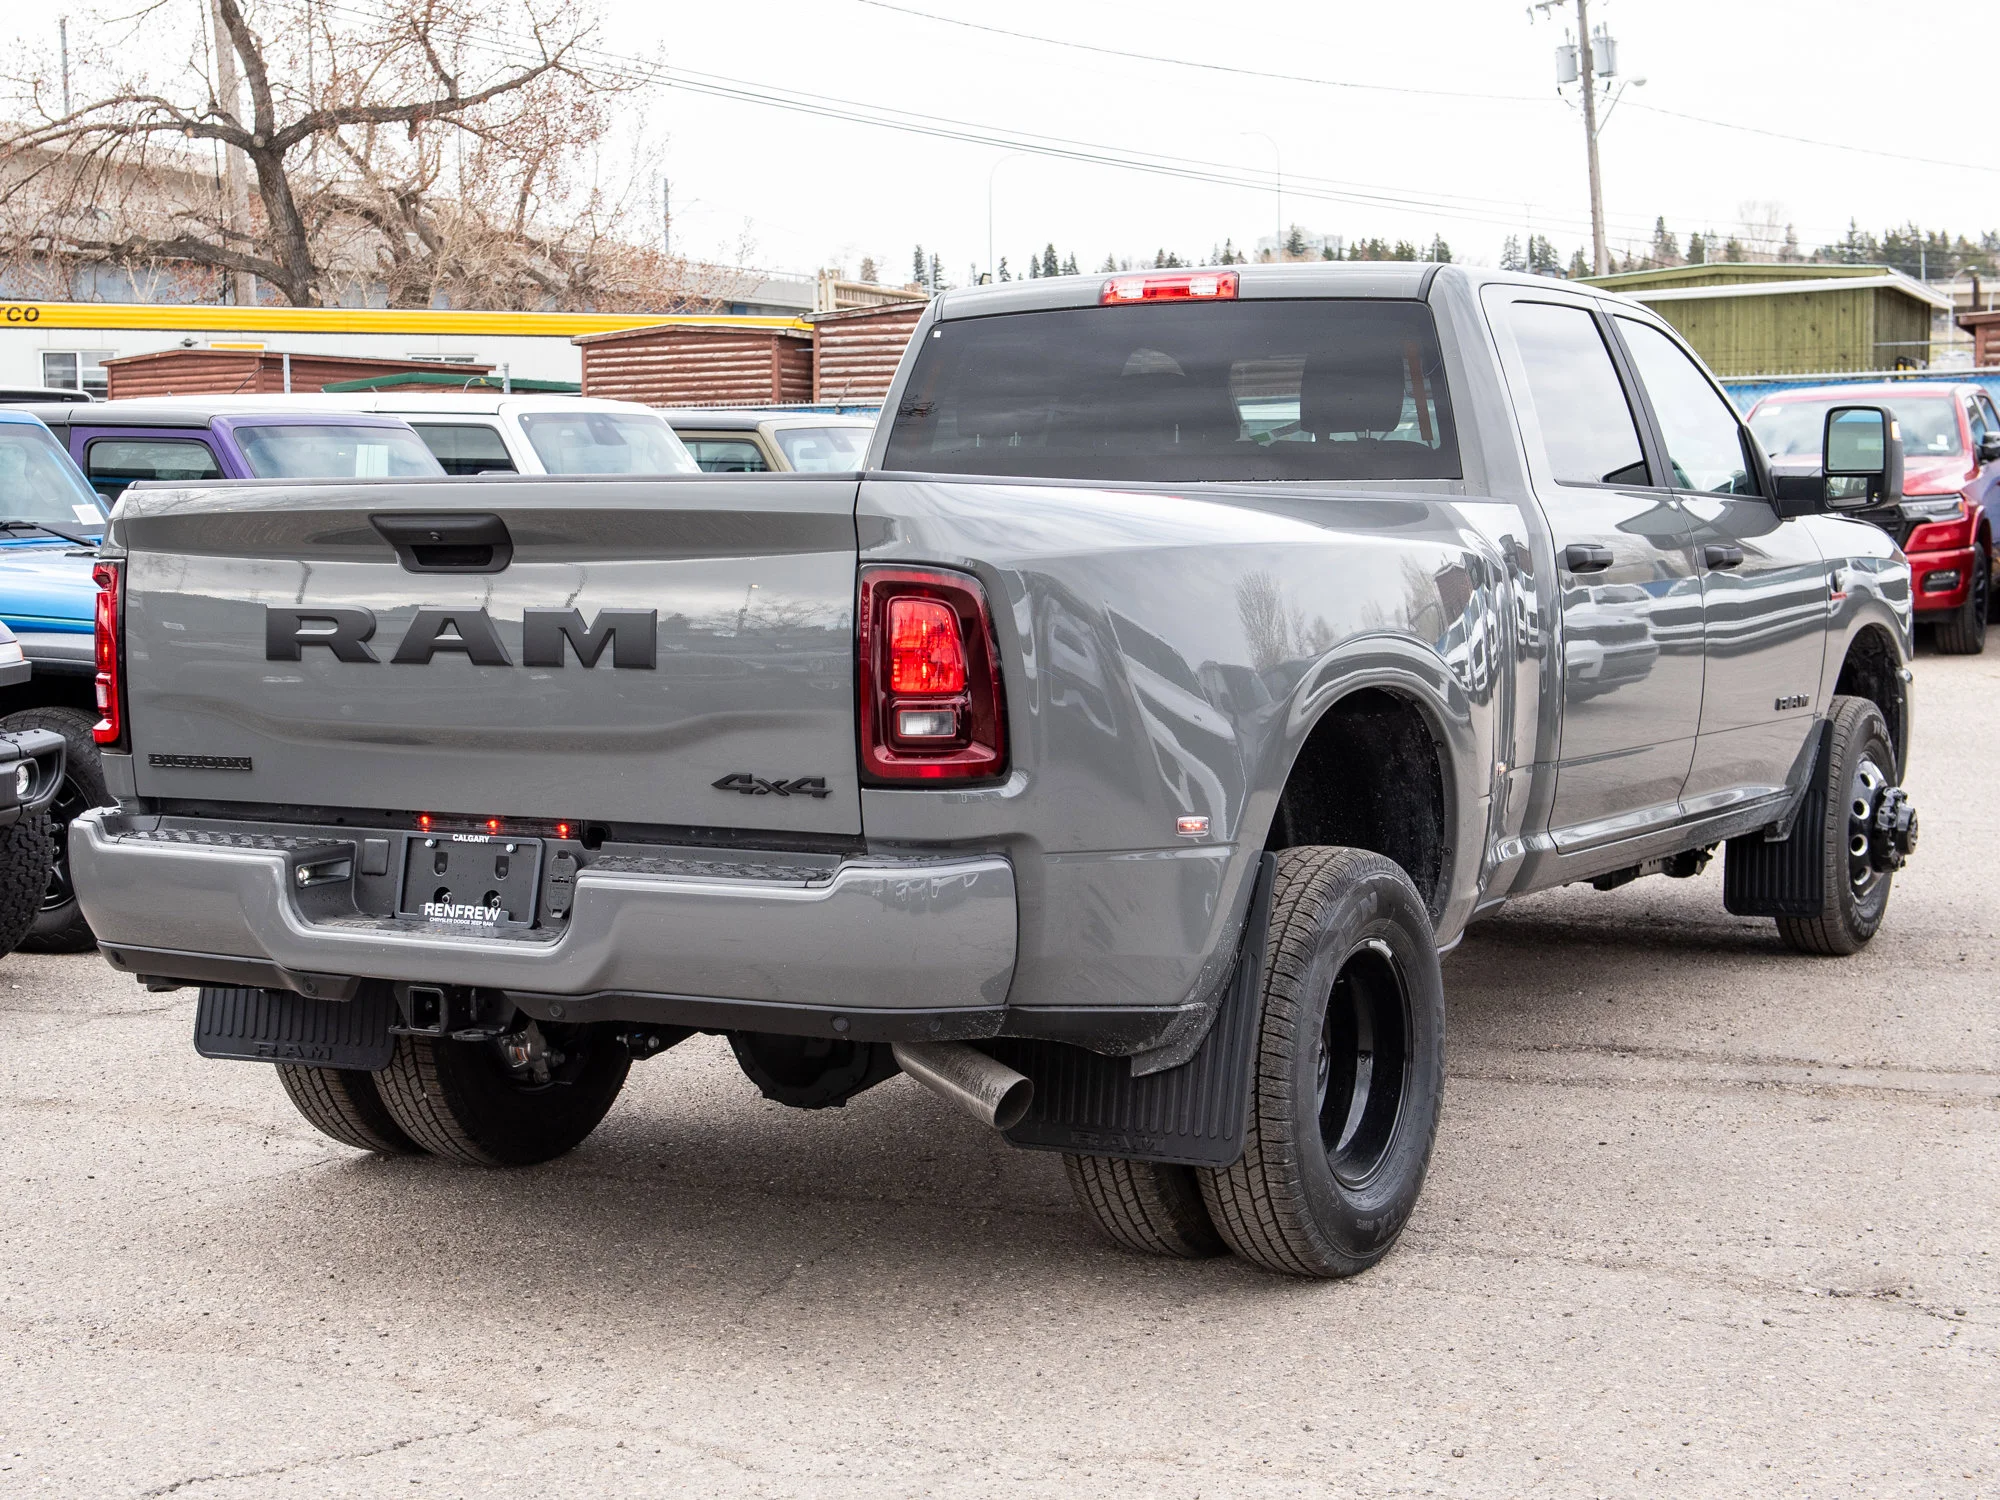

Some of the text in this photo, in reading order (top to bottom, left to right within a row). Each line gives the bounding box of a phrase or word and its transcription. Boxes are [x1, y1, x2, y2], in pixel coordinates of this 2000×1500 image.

[266, 603, 658, 670] RAM
[1774, 694, 1810, 711] RAM
[452, 833, 490, 843] CALGARY
[424, 902, 501, 921] RENFREW
[429, 916, 453, 924] CHRYSLER
